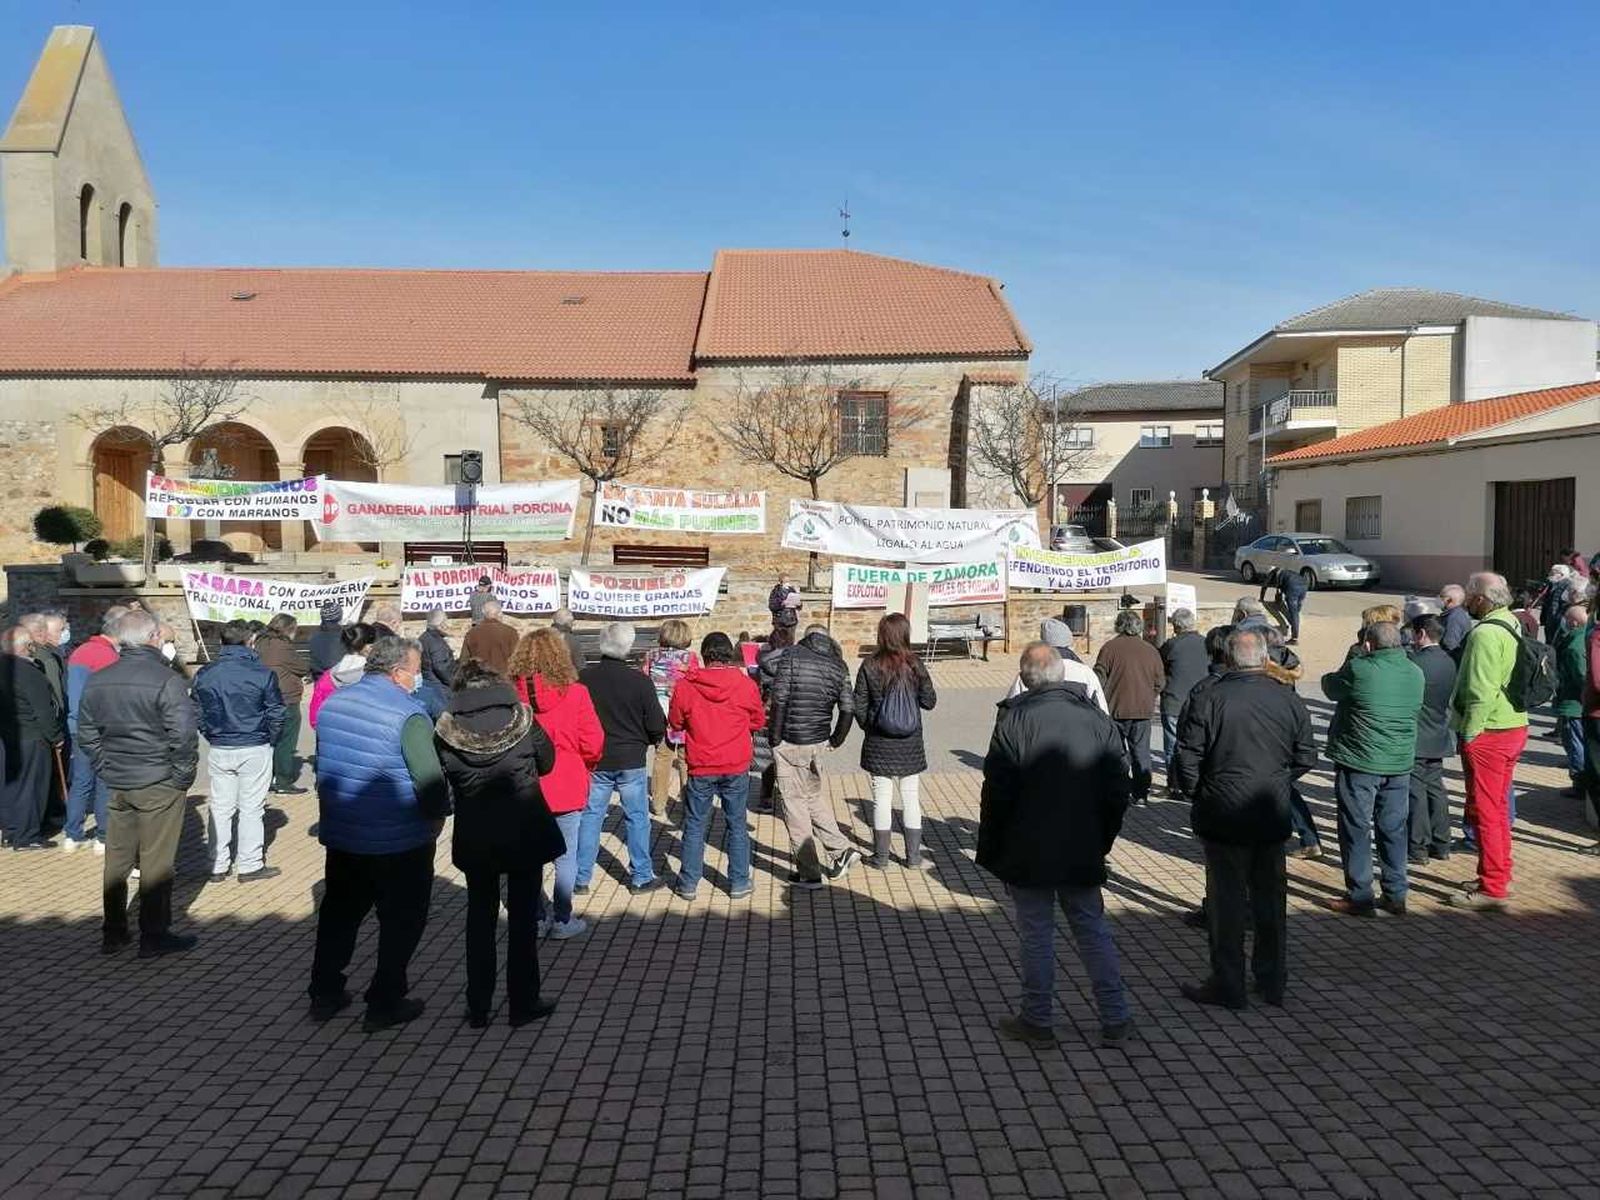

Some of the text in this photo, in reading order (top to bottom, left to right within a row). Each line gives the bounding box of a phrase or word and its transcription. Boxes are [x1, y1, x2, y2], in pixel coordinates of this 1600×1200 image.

[224, 496, 251, 506] CON
[255, 495, 318, 505] HUMANOS
[196, 508, 227, 518] CON
[229, 508, 300, 518] MARRANOS
[347, 503, 427, 515] GANADERIA
[512, 502, 572, 514] PORCINA
[602, 504, 631, 525] NO
[838, 515, 860, 526] POR
[877, 519, 944, 531] PATRIMONIO
[947, 521, 992, 531] NATURAL
[920, 540, 932, 549] AL
[935, 540, 964, 550] AGUA
[847, 562, 999, 584] FUERA DE ZAMORA
[1078, 567, 1092, 577] EL
[1096, 557, 1160, 576] TERRITORIO
[414, 572, 430, 587] AL
[589, 573, 686, 591] POZUELO
[1048, 576, 1111, 588] Y LA SALUD
[268, 585, 295, 597] CON
[300, 582, 368, 598] GANADERIA
[572, 589, 703, 602] NO QUIERE GRANJAS
[187, 591, 275, 611] TRADICIONAL,
